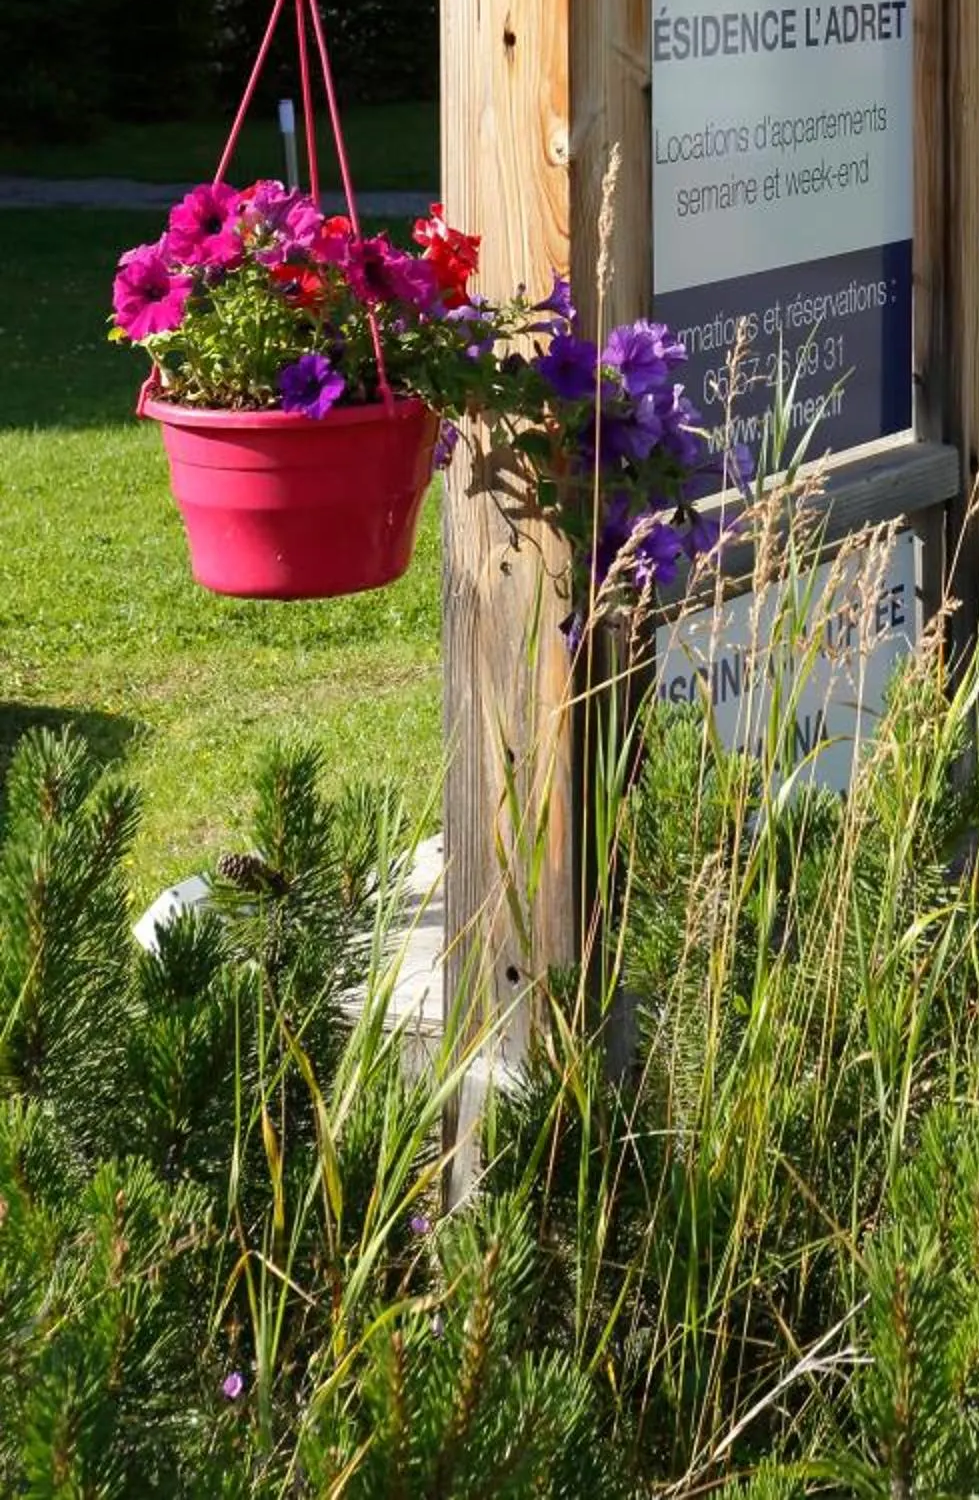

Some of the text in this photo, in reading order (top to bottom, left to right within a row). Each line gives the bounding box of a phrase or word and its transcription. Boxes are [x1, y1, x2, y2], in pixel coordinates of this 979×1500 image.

[653, 0, 907, 62] ÉSIDENCE L'ADRET
[655, 100, 888, 165] Locations d'appartements
[677, 151, 870, 217] semaine et week-end
[763, 300, 782, 333] et
[786, 279, 888, 327] réservations
[823, 333, 843, 371] 31
[706, 387, 846, 455] www.nmea.fr
